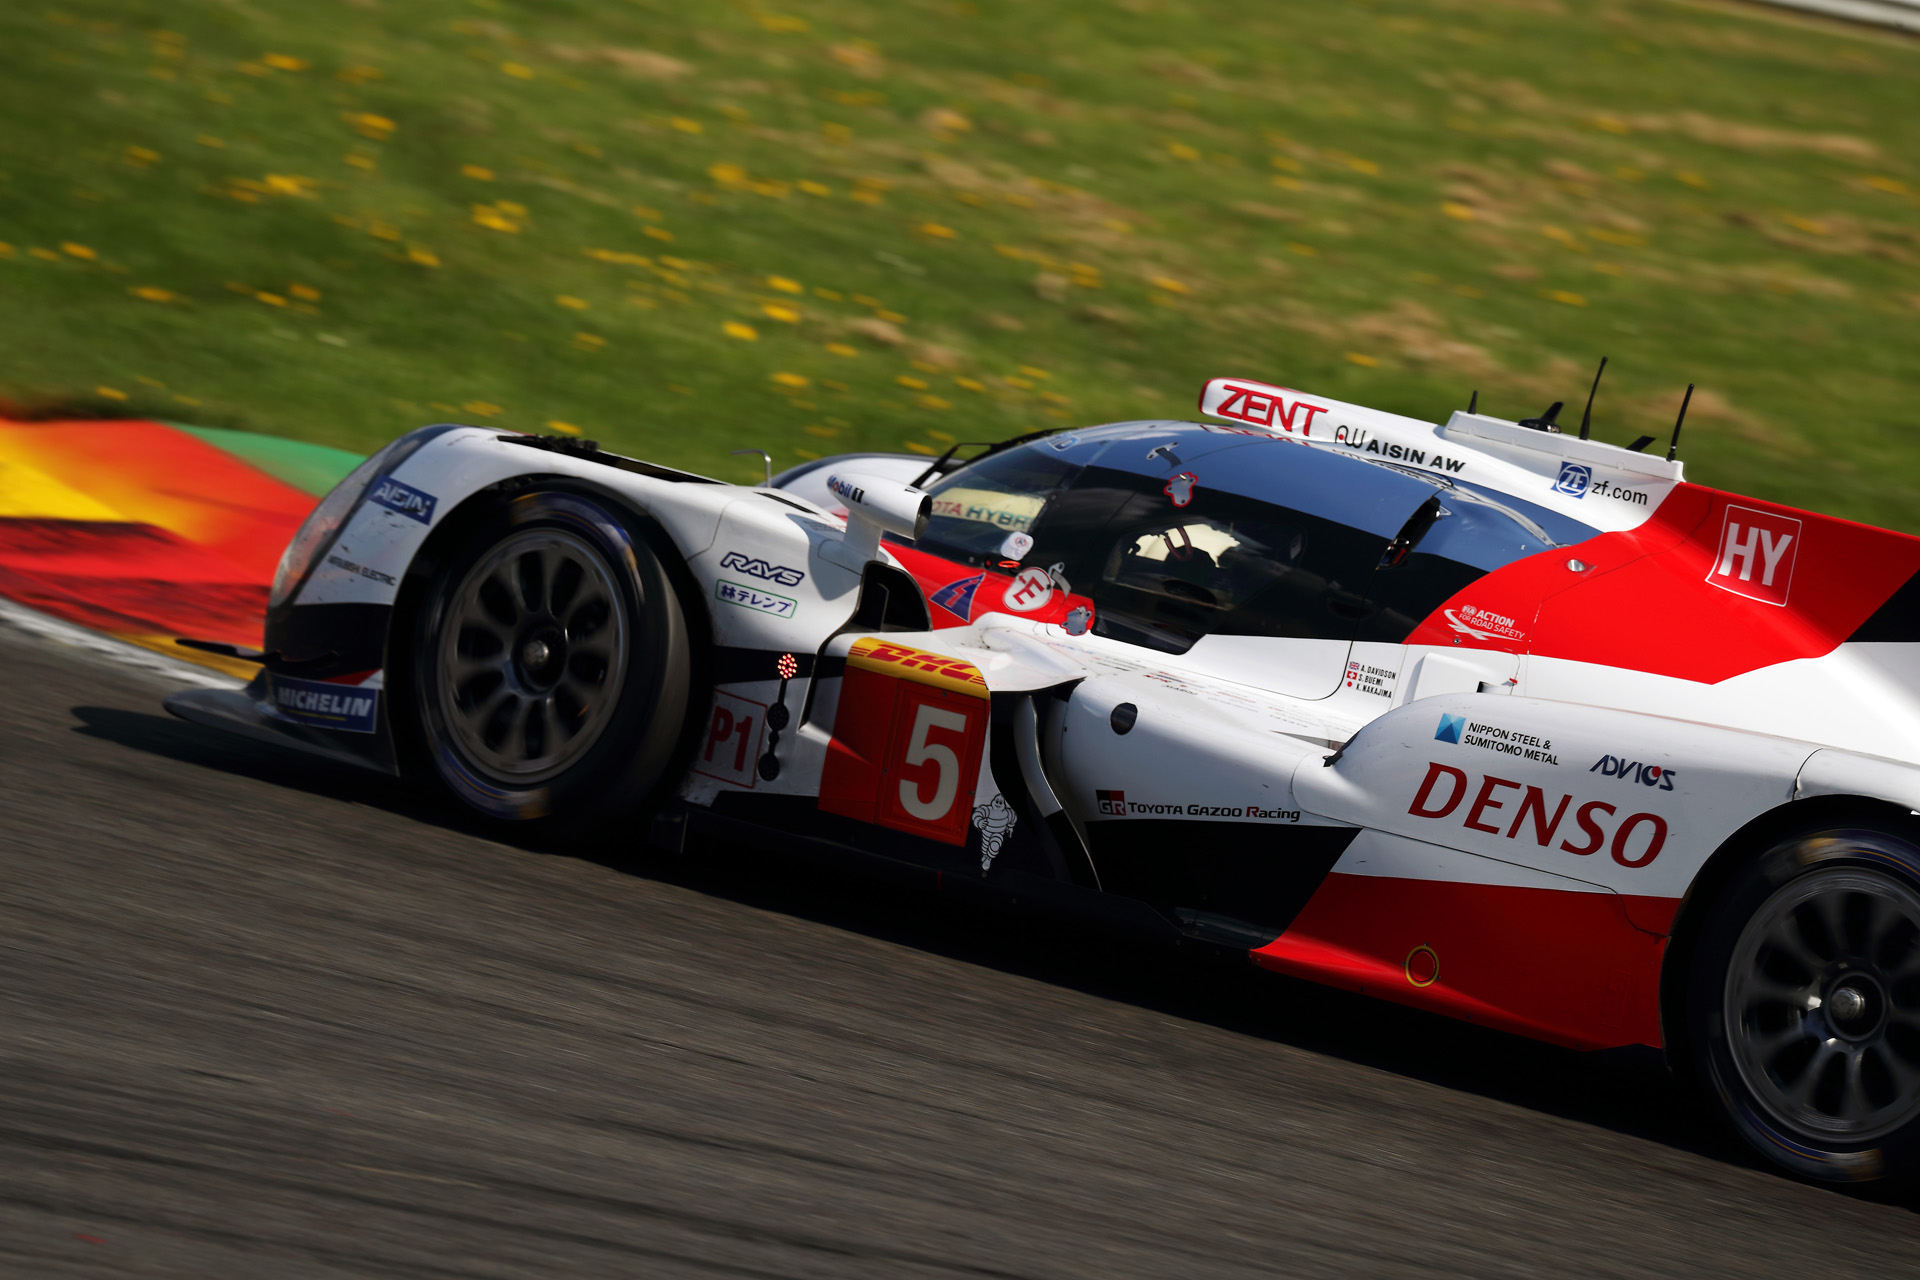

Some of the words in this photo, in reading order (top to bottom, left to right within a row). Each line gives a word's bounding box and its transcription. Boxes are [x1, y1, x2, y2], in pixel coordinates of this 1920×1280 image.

[1216, 384, 1329, 437] ZENT
[1366, 439, 1426, 465] AISIN
[1429, 455, 1466, 473] AW
[1563, 468, 1589, 490] ZF
[1591, 480, 1649, 506] zf.com
[373, 481, 432, 517] AISIN
[966, 505, 1034, 529] HYBR
[720, 551, 805, 587] RAYS
[1717, 522, 1794, 587] HY
[1459, 613, 1472, 622] FOR
[1470, 617, 1494, 630] ROAD
[1493, 624, 1526, 639] SAFETY
[1462, 605, 1476, 615] FIA
[1475, 610, 1515, 628] ACTION
[866, 643, 979, 681] DHL
[1360, 664, 1366, 673] A.
[1367, 666, 1397, 680] DAVIDSON
[1361, 684, 1392, 699] NAKAJIMA
[1364, 675, 1384, 687] BUEMI
[277, 685, 373, 718] MICHELIN
[1464, 734, 1523, 757] SUMITOMO
[1523, 749, 1559, 766] METAL
[1468, 722, 1509, 740] NIPPON
[1510, 732, 1541, 749] STEEL
[1542, 740, 1551, 750] &
[899, 703, 968, 821] 5
[1589, 754, 1676, 792] ADVICS
[1100, 800, 1126, 816] GR
[1128, 802, 1183, 815] TOYOTA
[1187, 804, 1242, 818] GAZOO
[1246, 806, 1301, 823] Racing
[1407, 761, 1668, 869] DENSO
